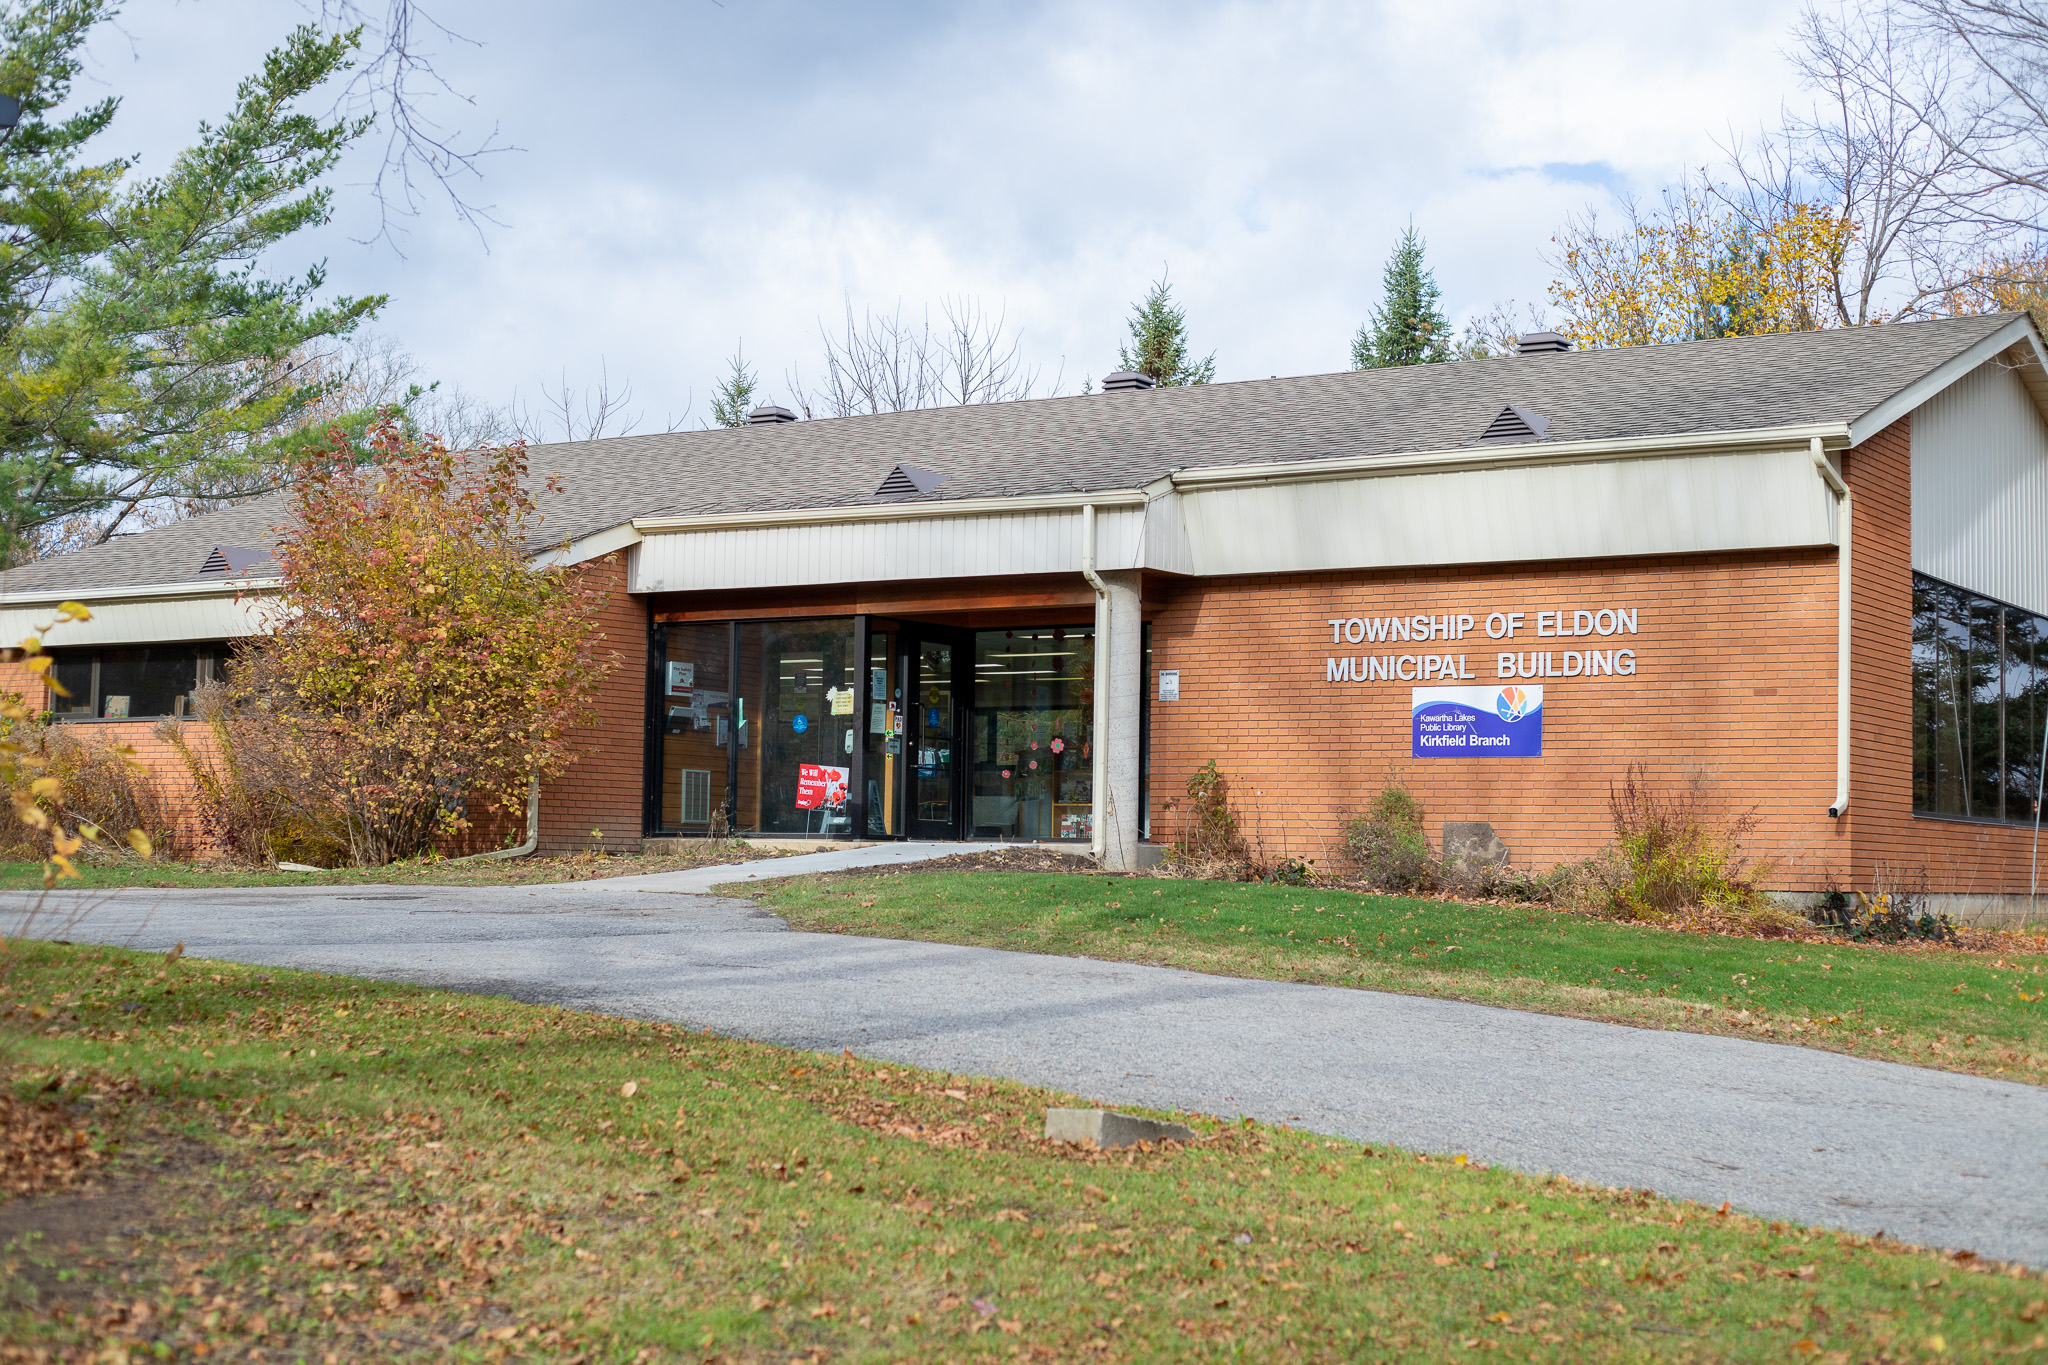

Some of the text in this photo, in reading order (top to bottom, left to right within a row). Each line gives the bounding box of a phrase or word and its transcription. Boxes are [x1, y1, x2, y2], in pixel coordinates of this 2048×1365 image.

[1327, 608, 1638, 644] TOWNSHIP OF ELDON
[1326, 648, 1637, 682] MUNICIPAL BUILDING
[1420, 713, 1476, 722] Kawartha Lakes
[1420, 723, 1467, 733] Public Library
[1420, 734, 1510, 747] Kirkfield Branch
[801, 768, 819, 777] We Will
[800, 777, 827, 787] Remember
[799, 786, 813, 795] Them
